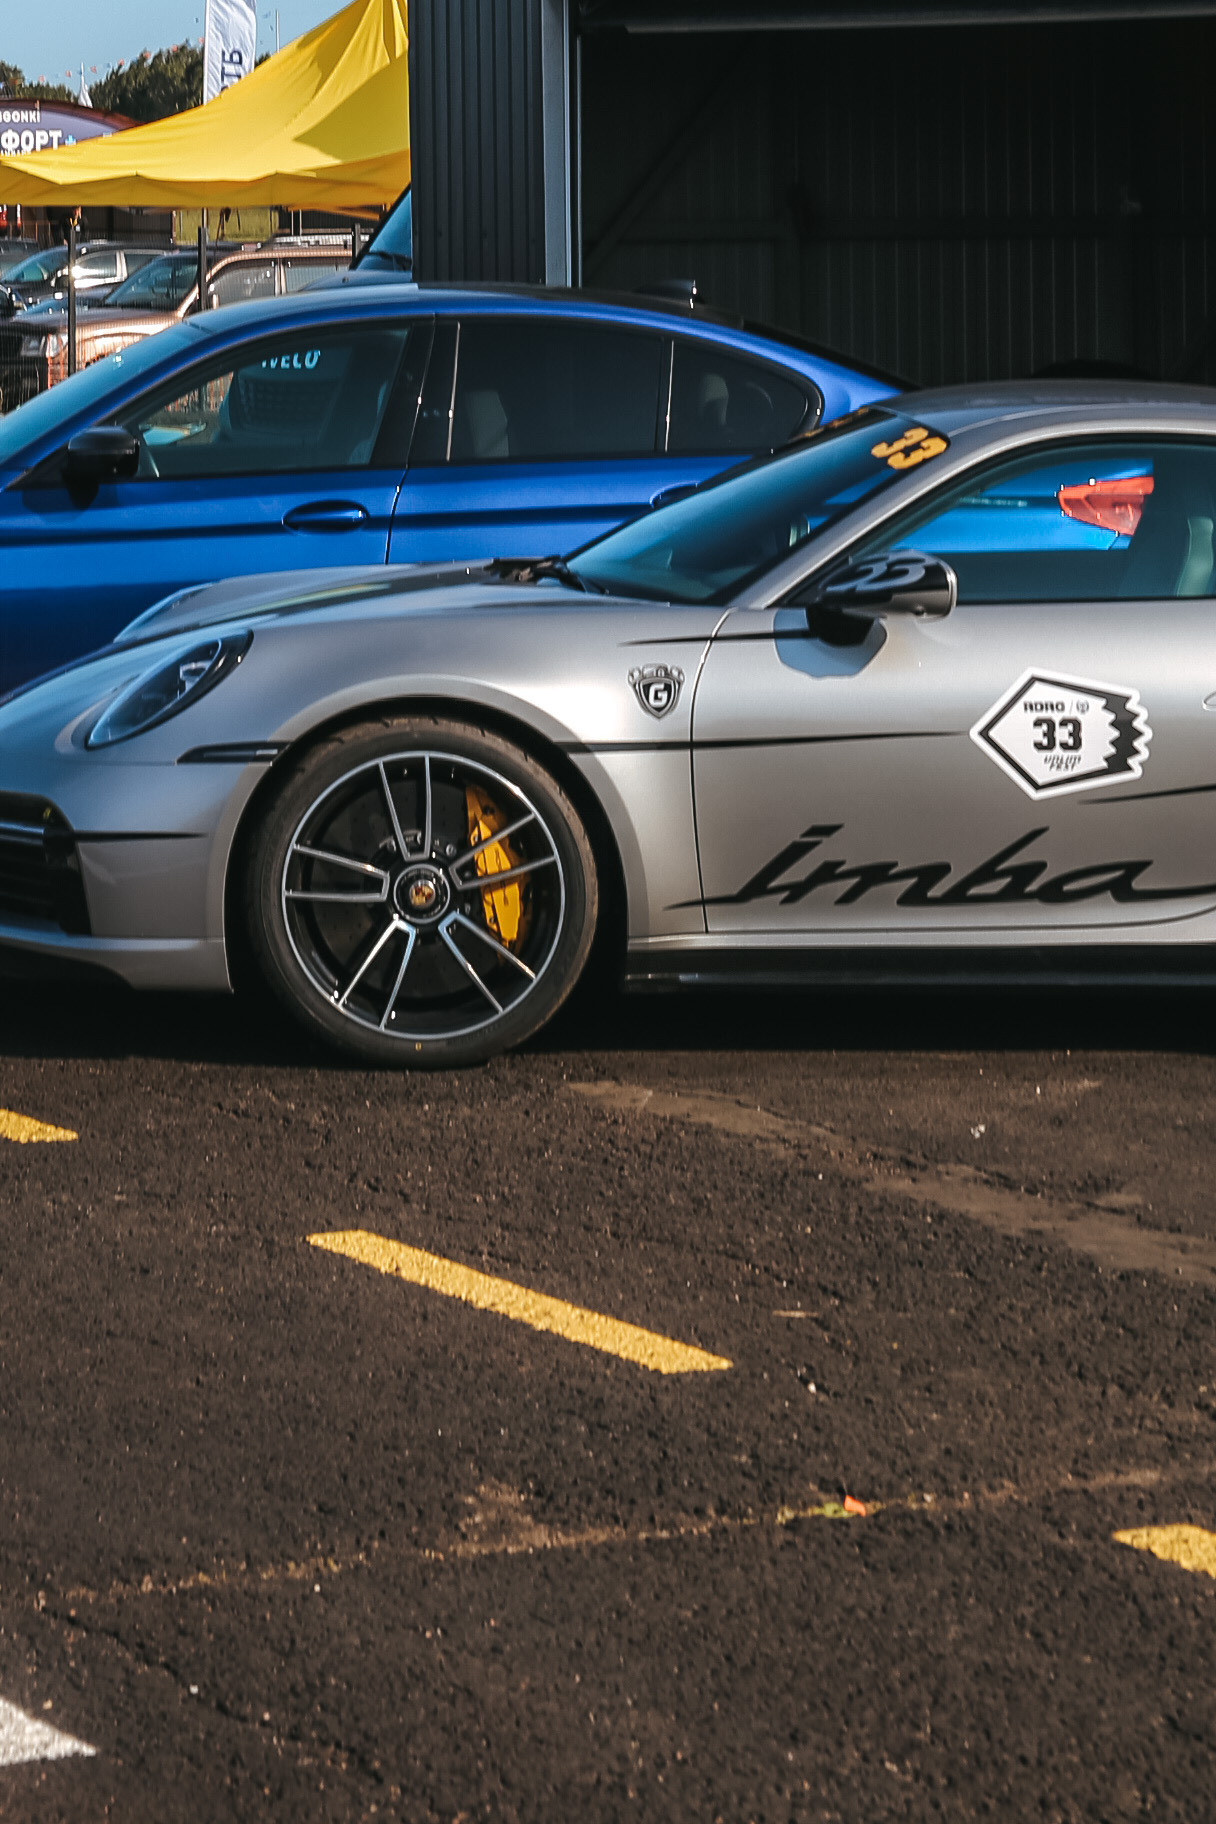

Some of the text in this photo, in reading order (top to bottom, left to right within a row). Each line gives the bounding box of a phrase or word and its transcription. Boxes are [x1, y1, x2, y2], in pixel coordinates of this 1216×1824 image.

[220, 48, 243, 91] ТБ
[871, 427, 947, 469] 33
[1033, 717, 1082, 751] 33
